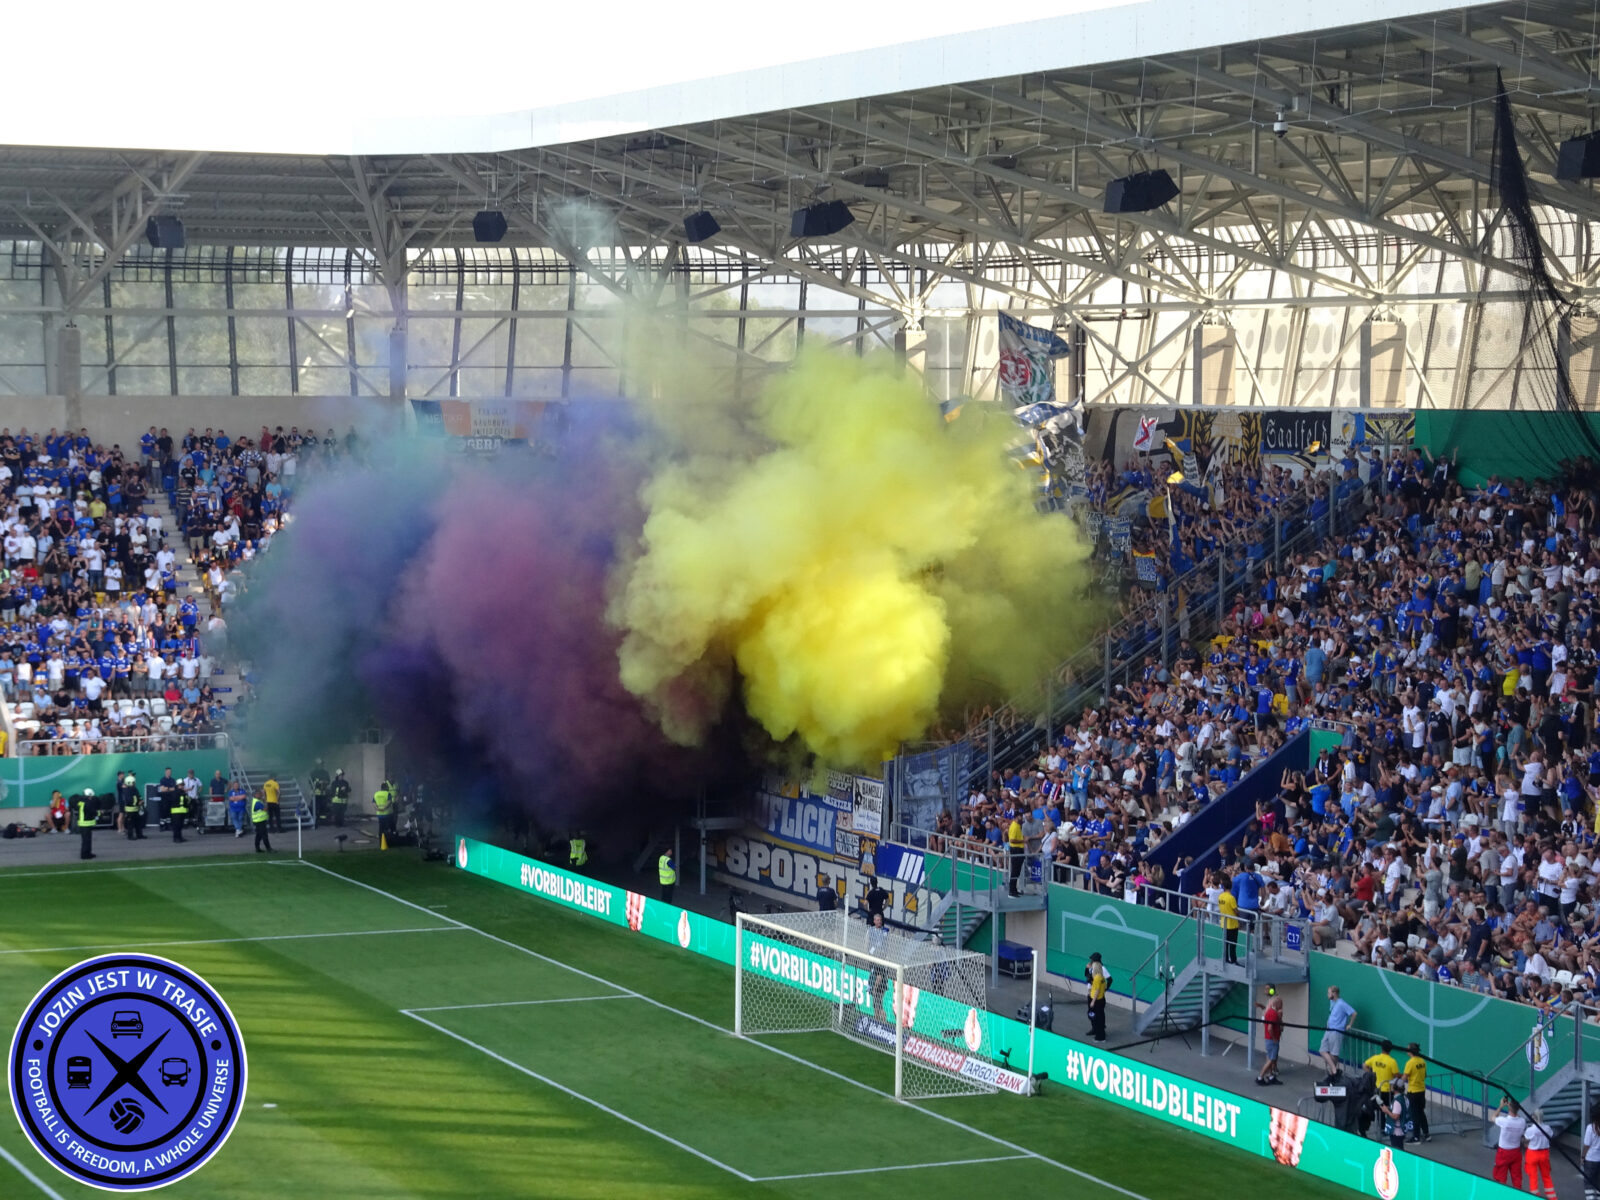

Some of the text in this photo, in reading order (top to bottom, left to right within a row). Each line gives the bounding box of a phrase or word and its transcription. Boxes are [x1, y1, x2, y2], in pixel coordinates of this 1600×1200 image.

[520, 863, 612, 915] #VORBILDBLEIBT
[1287, 931, 1300, 944] C17
[750, 942, 871, 1008] #VORBILDBLEIBT
[1066, 1049, 1241, 1138] #VORBILDBLEIBT
